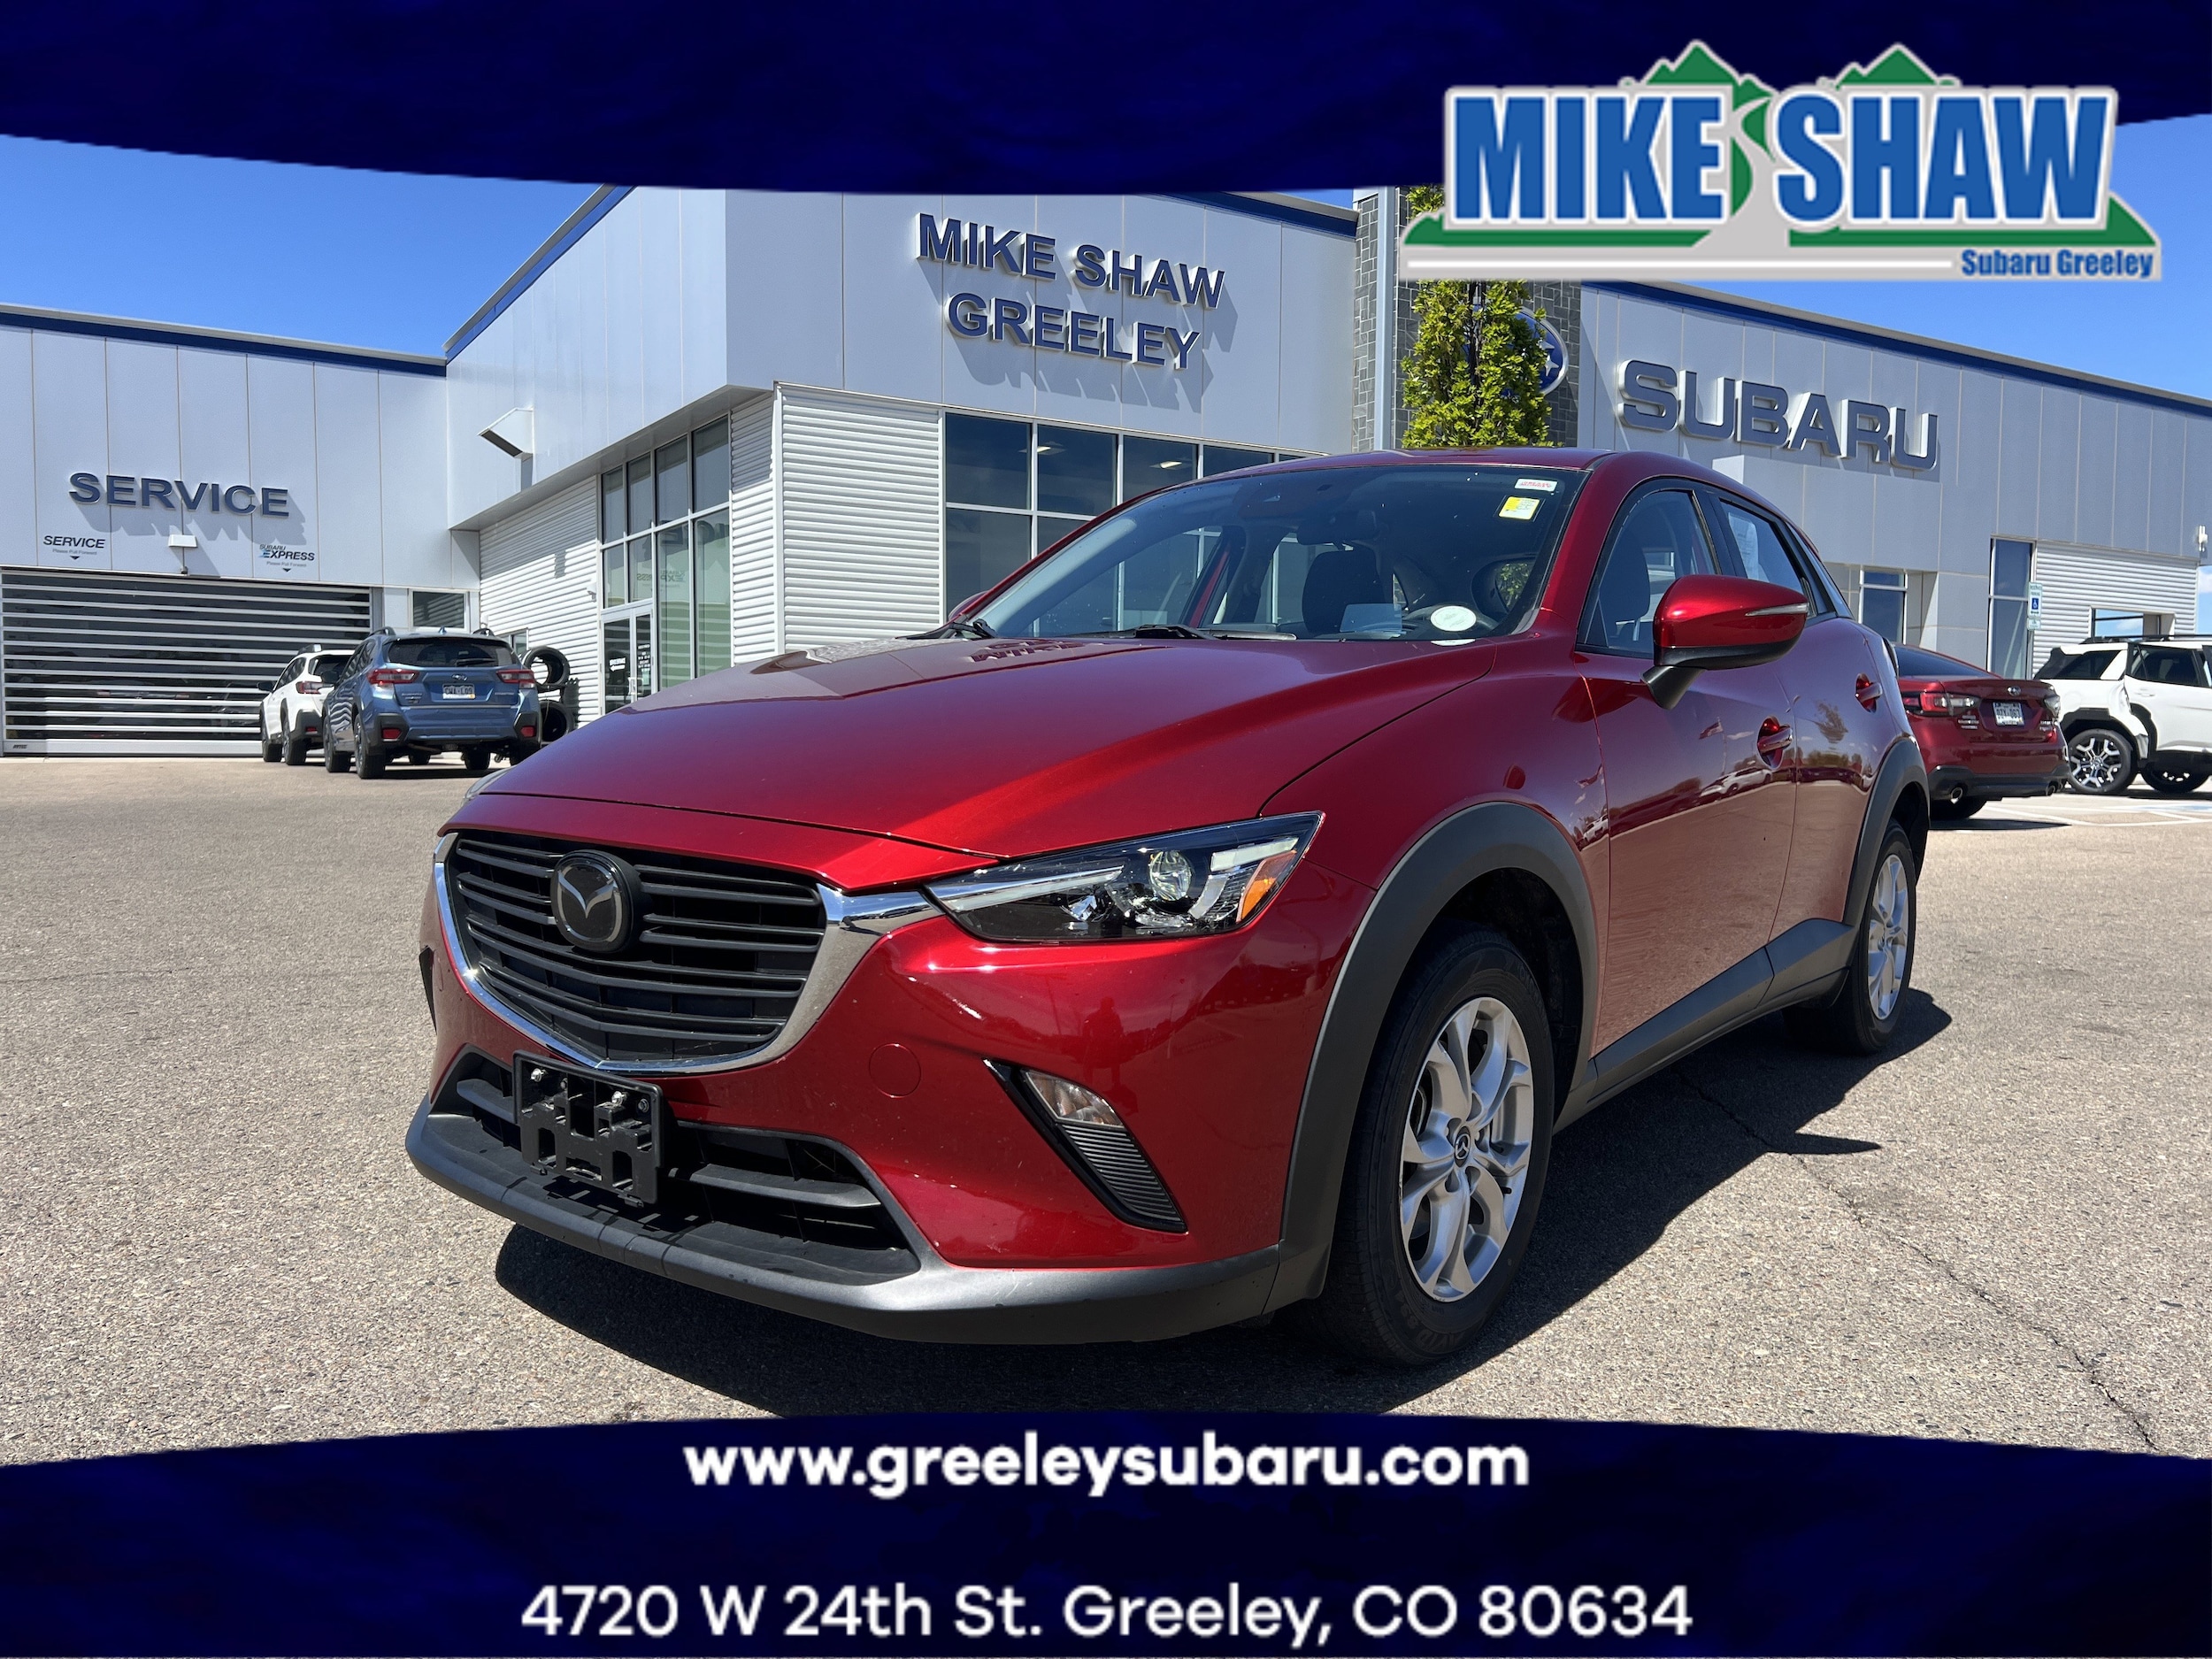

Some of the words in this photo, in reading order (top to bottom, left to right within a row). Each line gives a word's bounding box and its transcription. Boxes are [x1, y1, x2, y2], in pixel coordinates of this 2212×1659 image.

[916, 212, 1056, 281] MIKE
[1071, 243, 1225, 310] SHAW
[945, 292, 1201, 371] GREELEY
[1617, 358, 1940, 472] SUBARU
[68, 472, 289, 518] SERVICE
[42, 535, 105, 549] SERVICE
[262, 549, 315, 561] EXPRESS
